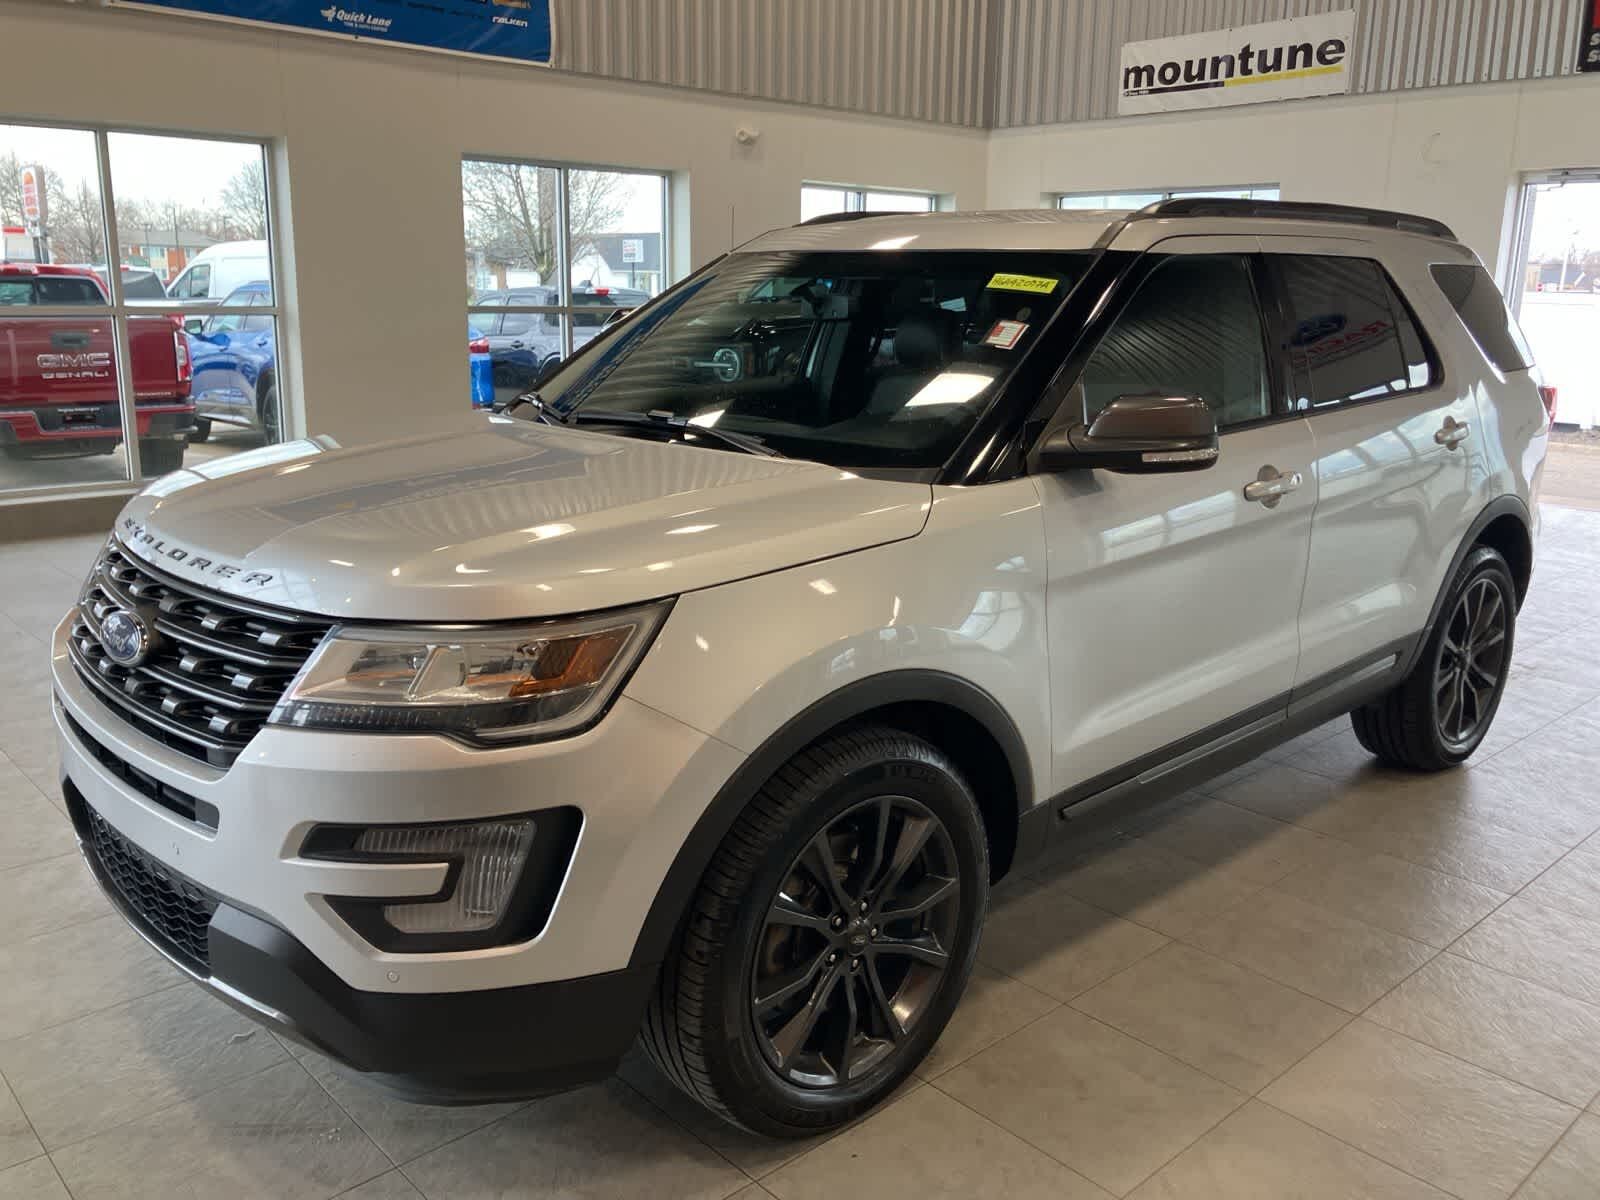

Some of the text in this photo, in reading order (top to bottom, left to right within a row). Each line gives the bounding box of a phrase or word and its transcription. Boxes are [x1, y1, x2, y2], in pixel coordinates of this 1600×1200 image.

[336, 9, 366, 22] Quick
[366, 14, 393, 27] Lane
[1123, 38, 1346, 89] mountune
[37, 352, 110, 368] GMC
[41, 370, 109, 380] DENALI
[124, 517, 273, 587] EXPLORER
